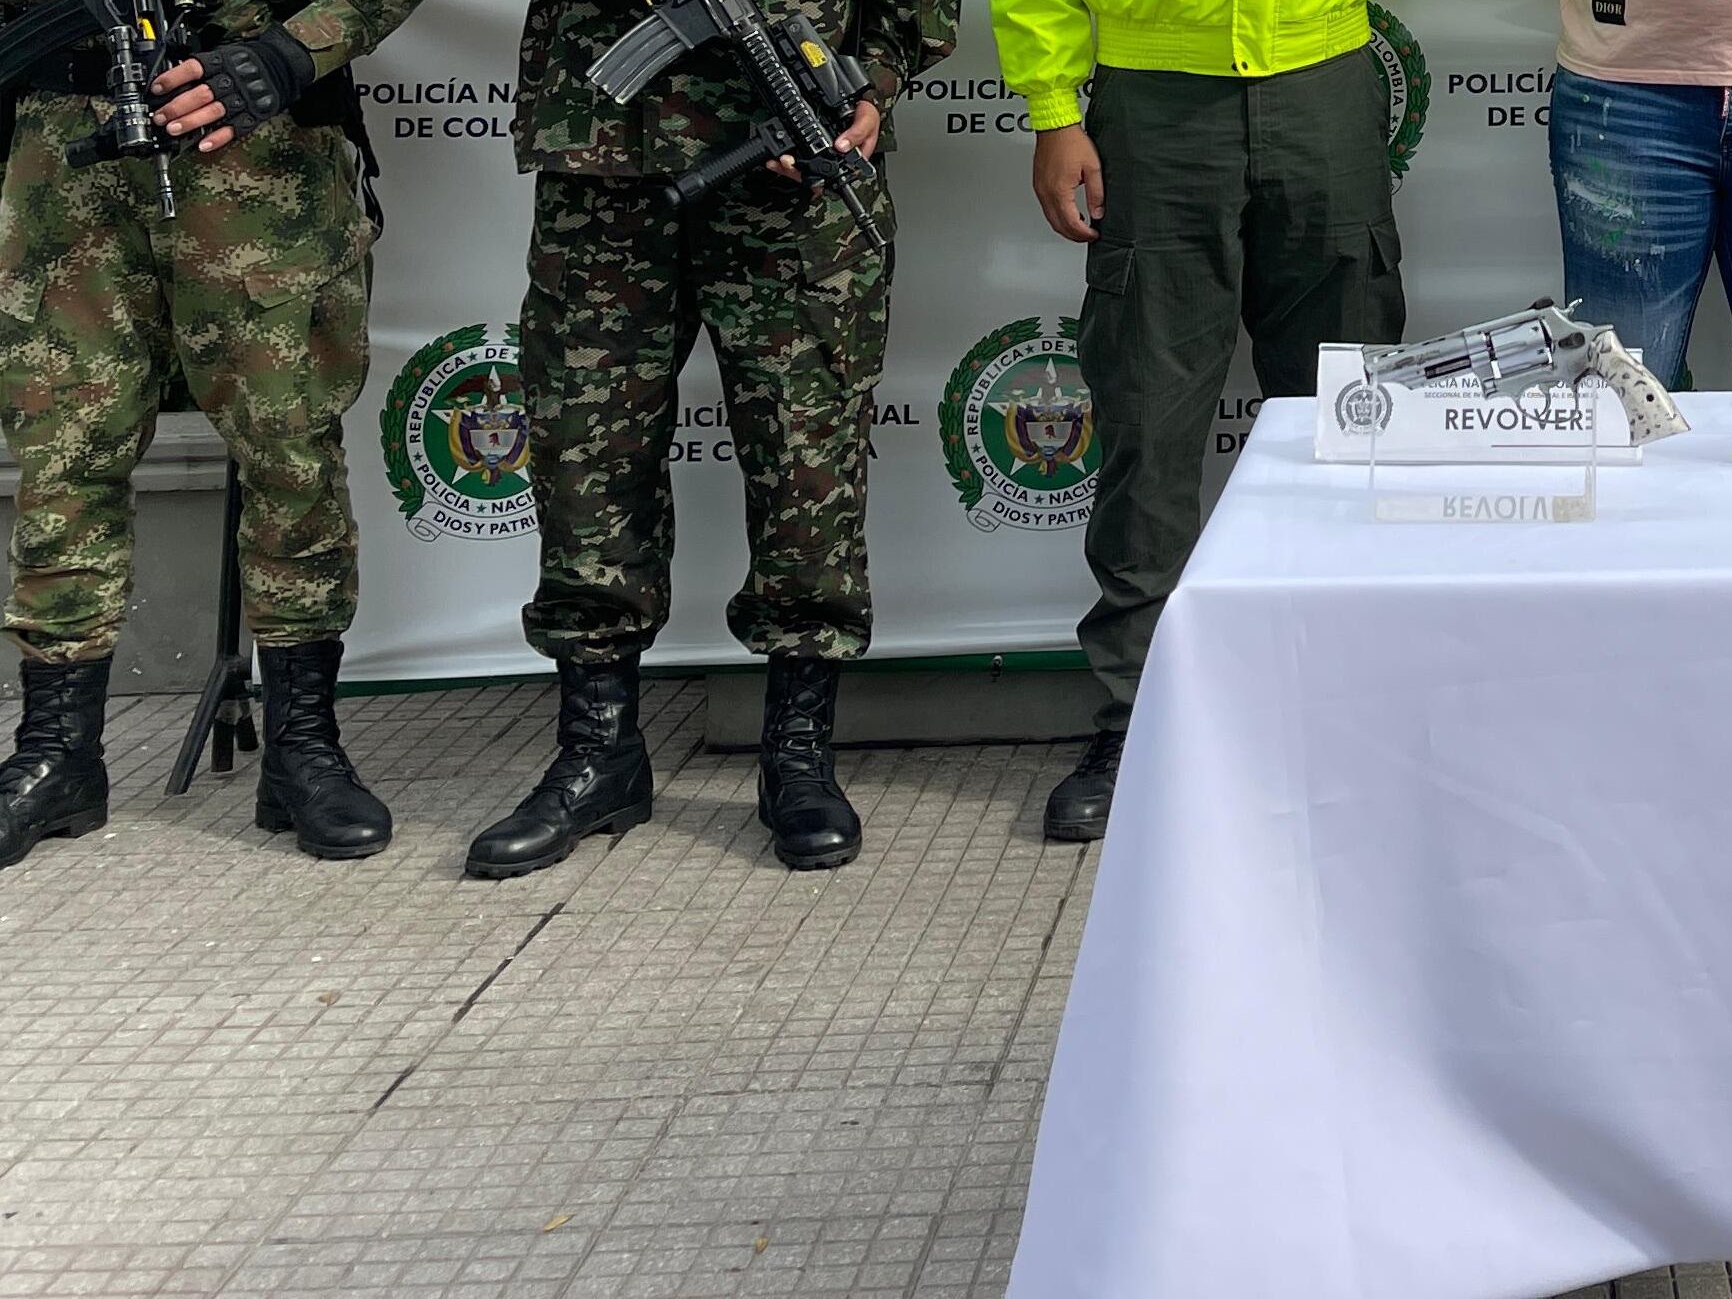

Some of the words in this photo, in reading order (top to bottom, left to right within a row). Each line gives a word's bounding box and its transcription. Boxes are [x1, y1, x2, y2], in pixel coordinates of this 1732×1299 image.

[1595, 0, 1622, 16] DIOR
[354, 77, 477, 104] POLICÍA
[394, 117, 434, 138] DE
[947, 113, 985, 133] DE
[1487, 107, 1531, 128] DE
[485, 348, 509, 359] DE
[1042, 340, 1064, 352] DE
[1445, 408, 1584, 430] REVOLVER
[433, 510, 476, 532] DIOS
[992, 501, 1030, 525] DIOS
